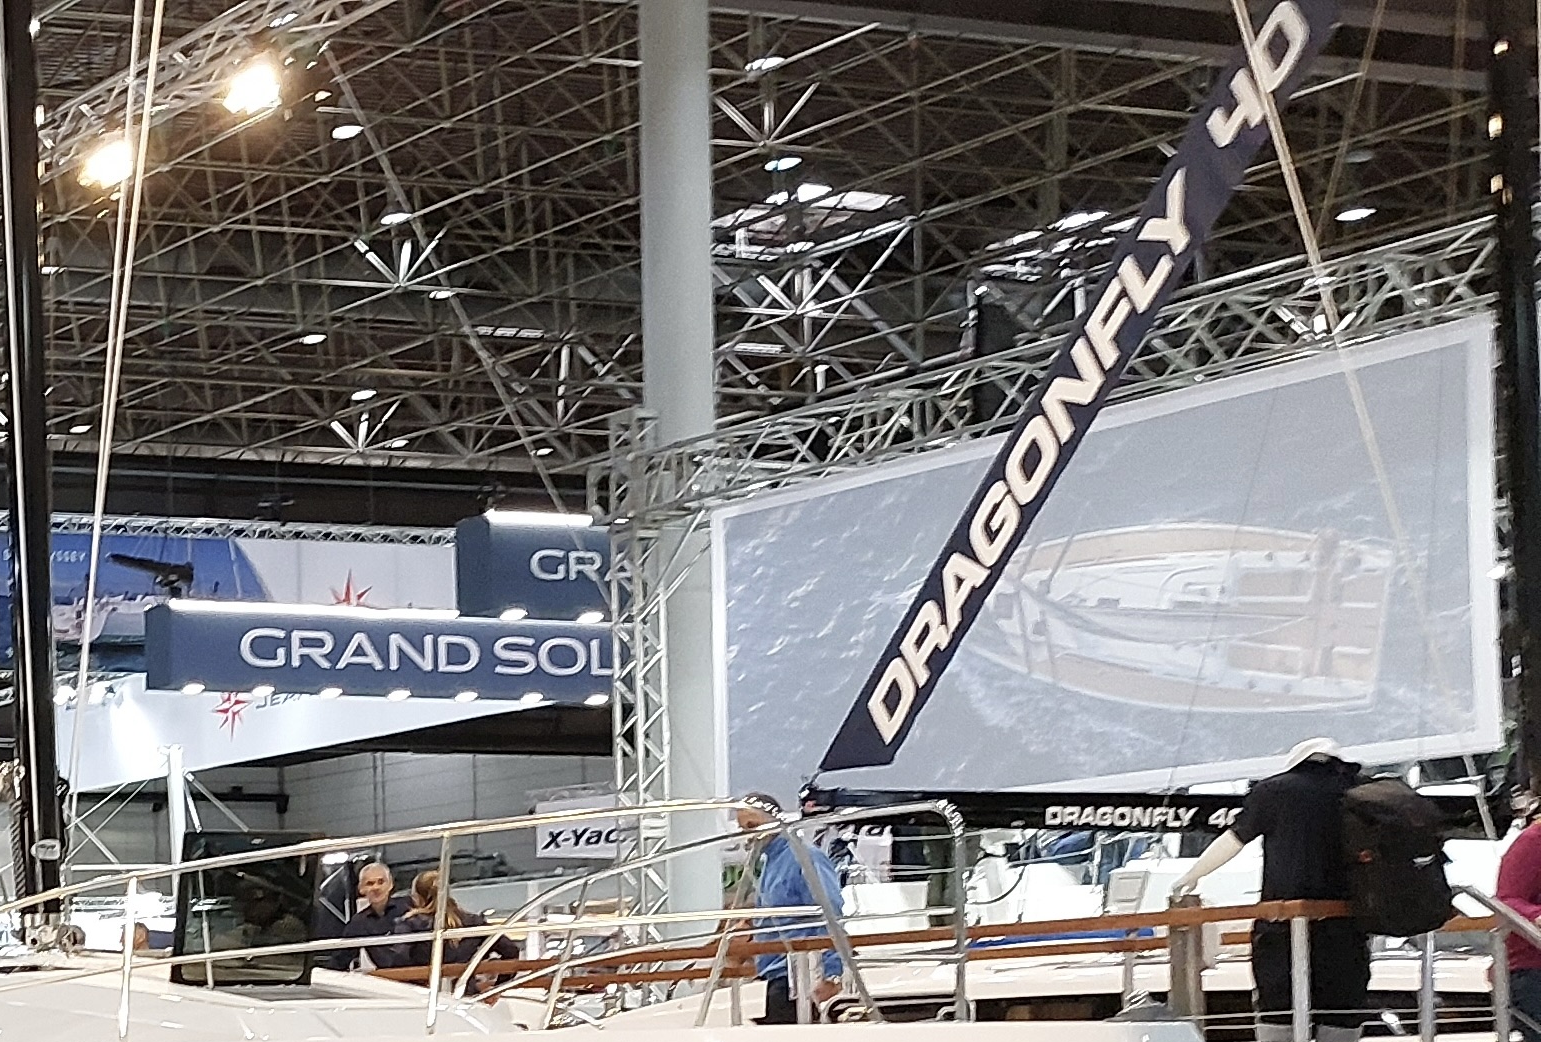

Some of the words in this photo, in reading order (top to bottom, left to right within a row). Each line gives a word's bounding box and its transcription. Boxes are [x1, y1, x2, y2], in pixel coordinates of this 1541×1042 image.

[866, 168, 1191, 746] DRAGONFLY
[1206, 0, 1311, 148] 40
[529, 548, 632, 581] GRA
[239, 627, 481, 673] GRAND
[492, 636, 614, 676] SOL
[1044, 805, 1199, 828] DRAGONFLY
[541, 826, 623, 851] X-Yac
